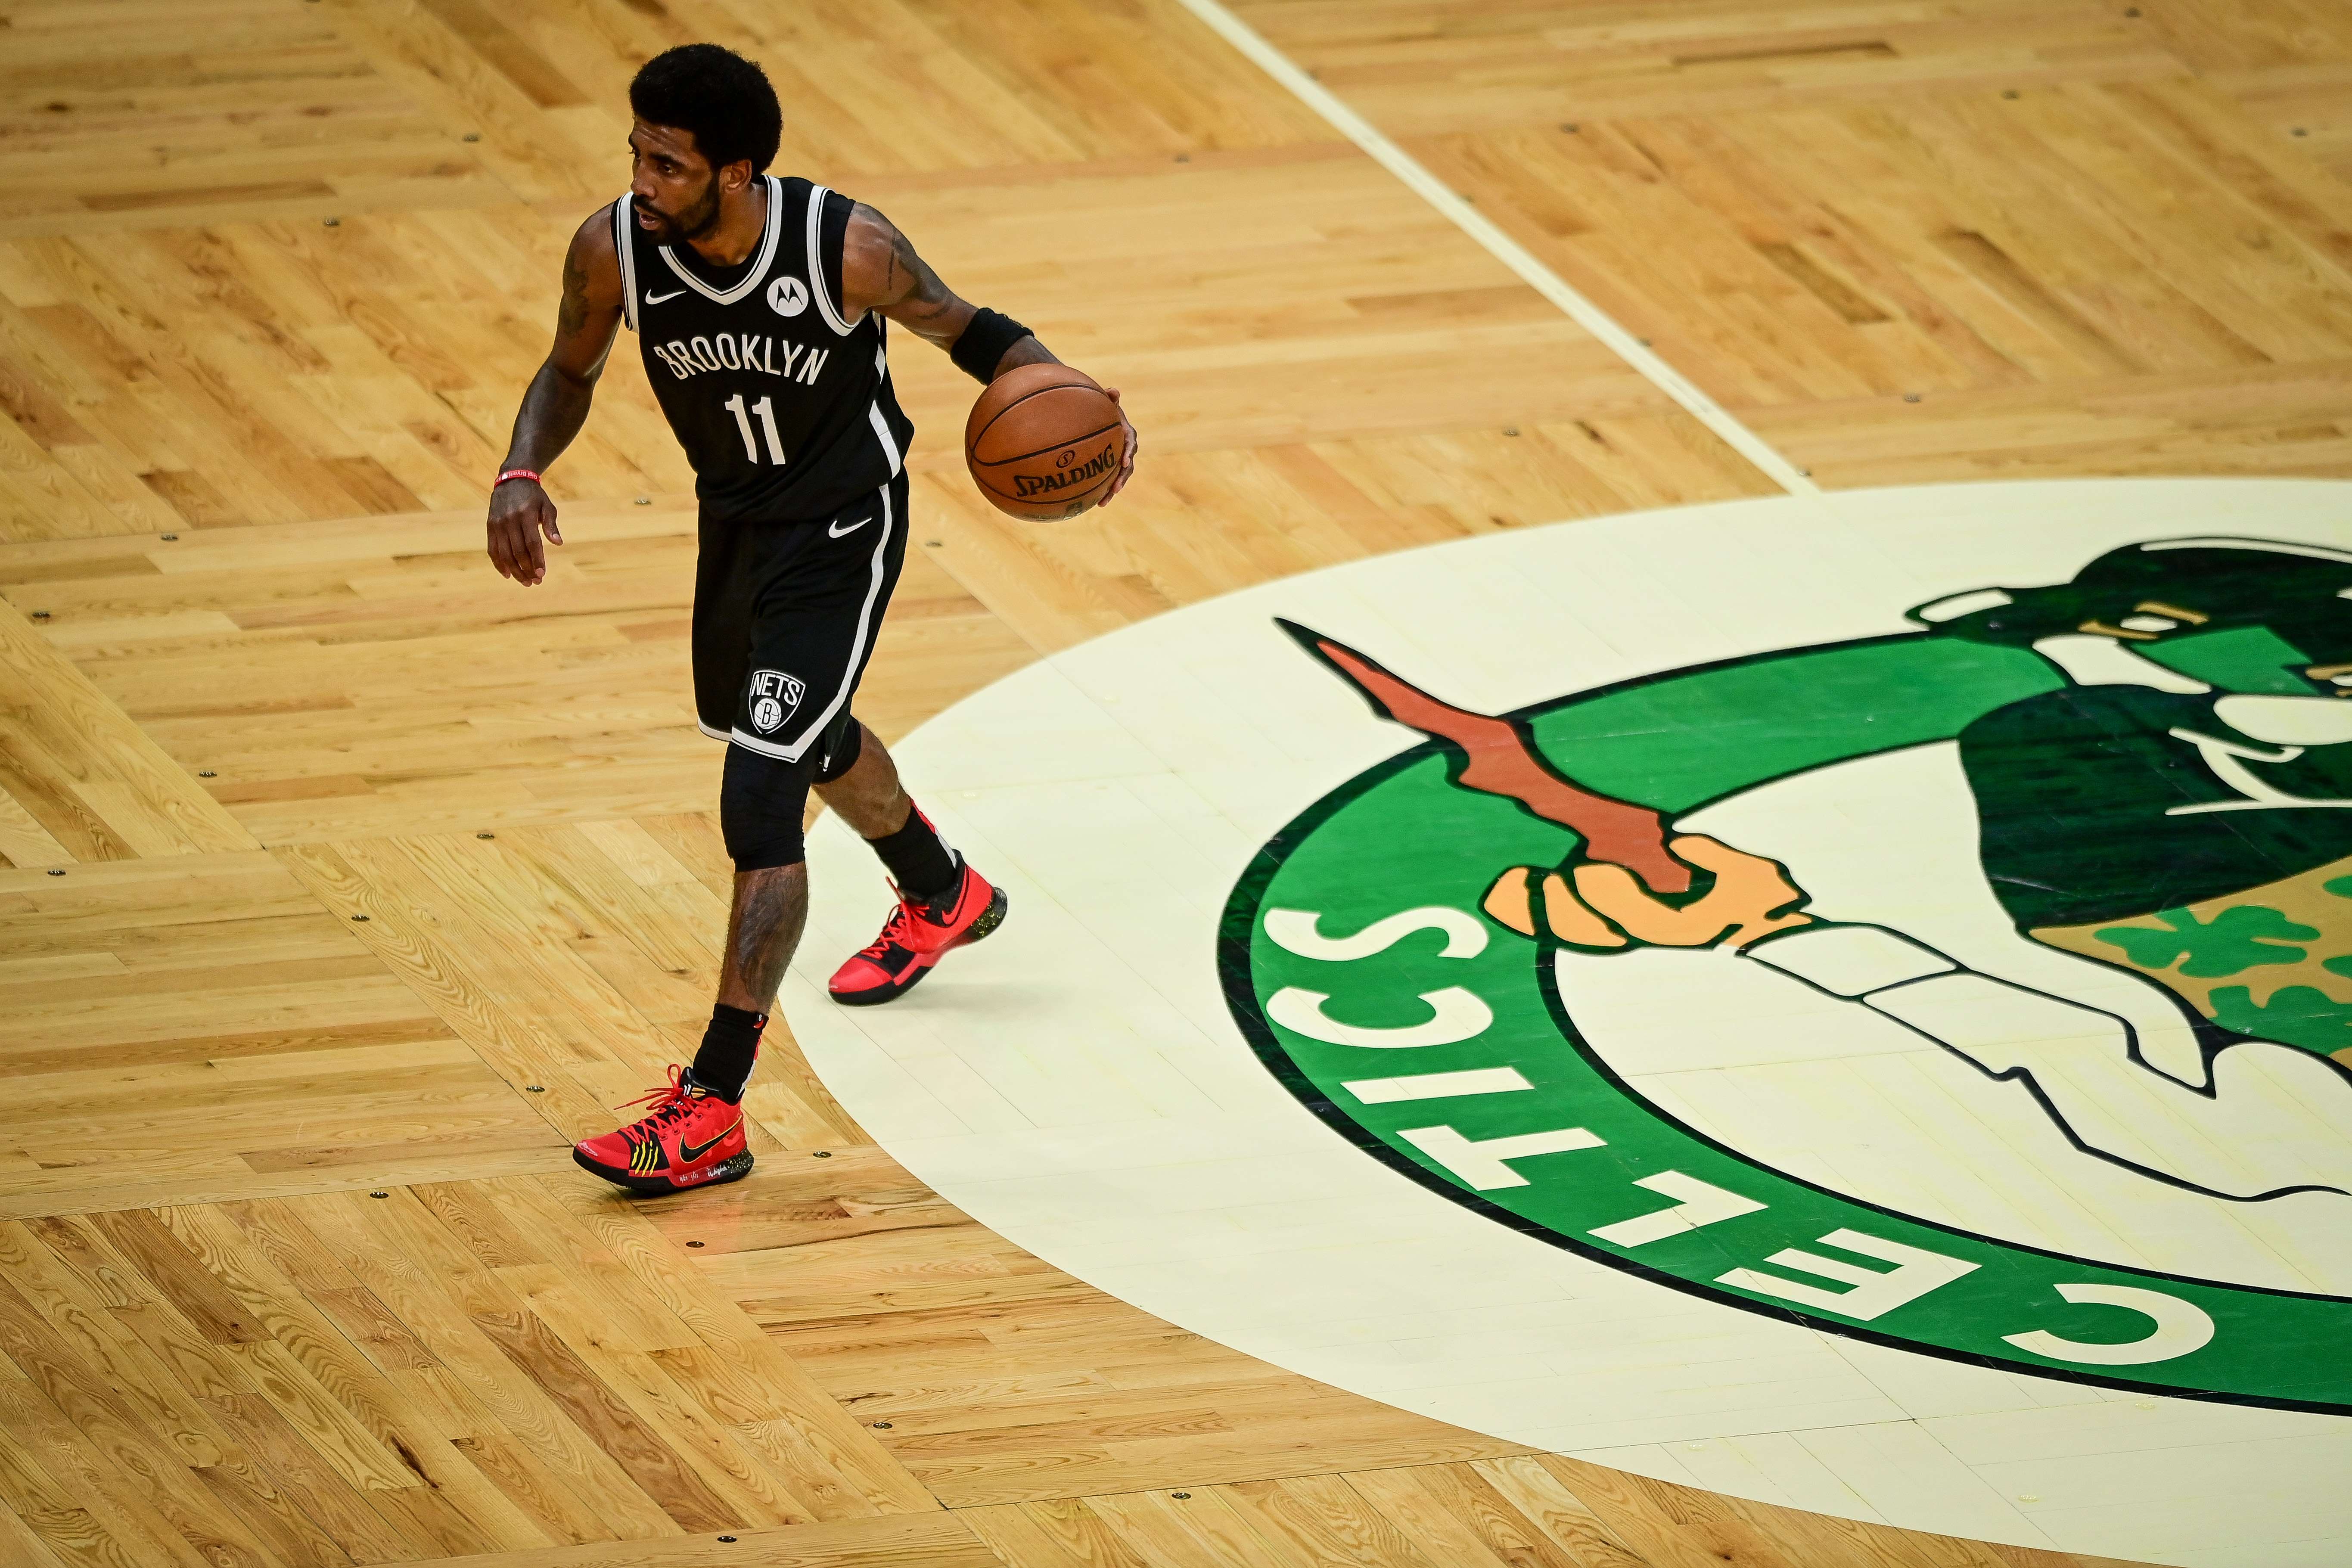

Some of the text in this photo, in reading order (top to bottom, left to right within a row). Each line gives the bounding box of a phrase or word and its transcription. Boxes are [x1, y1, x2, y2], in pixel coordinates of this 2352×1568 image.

[653, 333, 829, 385] BROOKLYN
[724, 394, 786, 465] 11
[1013, 442, 1115, 497] SPALDING
[751, 673, 800, 706] NETS
[761, 702, 772, 725] B
[1264, 907, 2214, 1365] CELTICS
